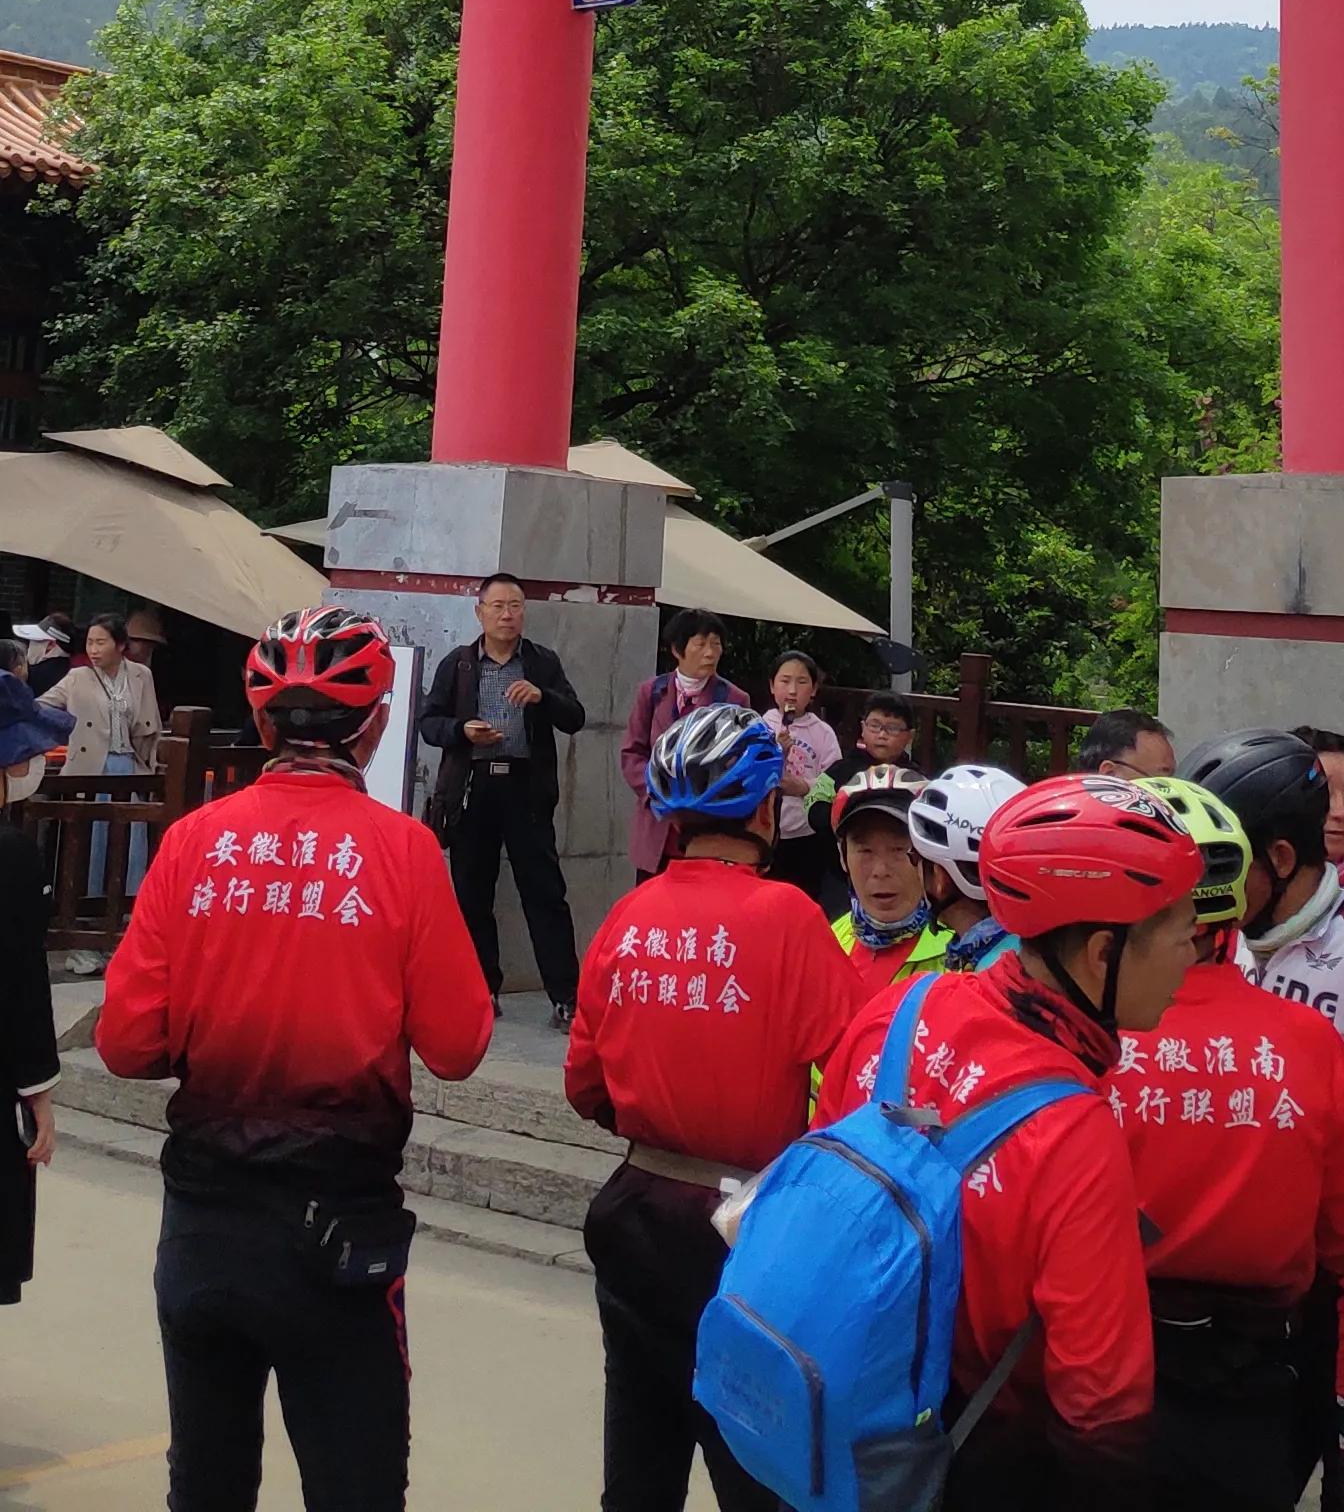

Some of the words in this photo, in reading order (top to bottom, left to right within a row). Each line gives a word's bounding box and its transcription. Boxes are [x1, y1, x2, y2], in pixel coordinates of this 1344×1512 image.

[206, 830, 363, 880] 安徽淮南
[188, 876, 373, 927] 骑行联盟会
[616, 925, 737, 969] 安徽淮南
[1114, 1036, 1285, 1082] 安徽淮南
